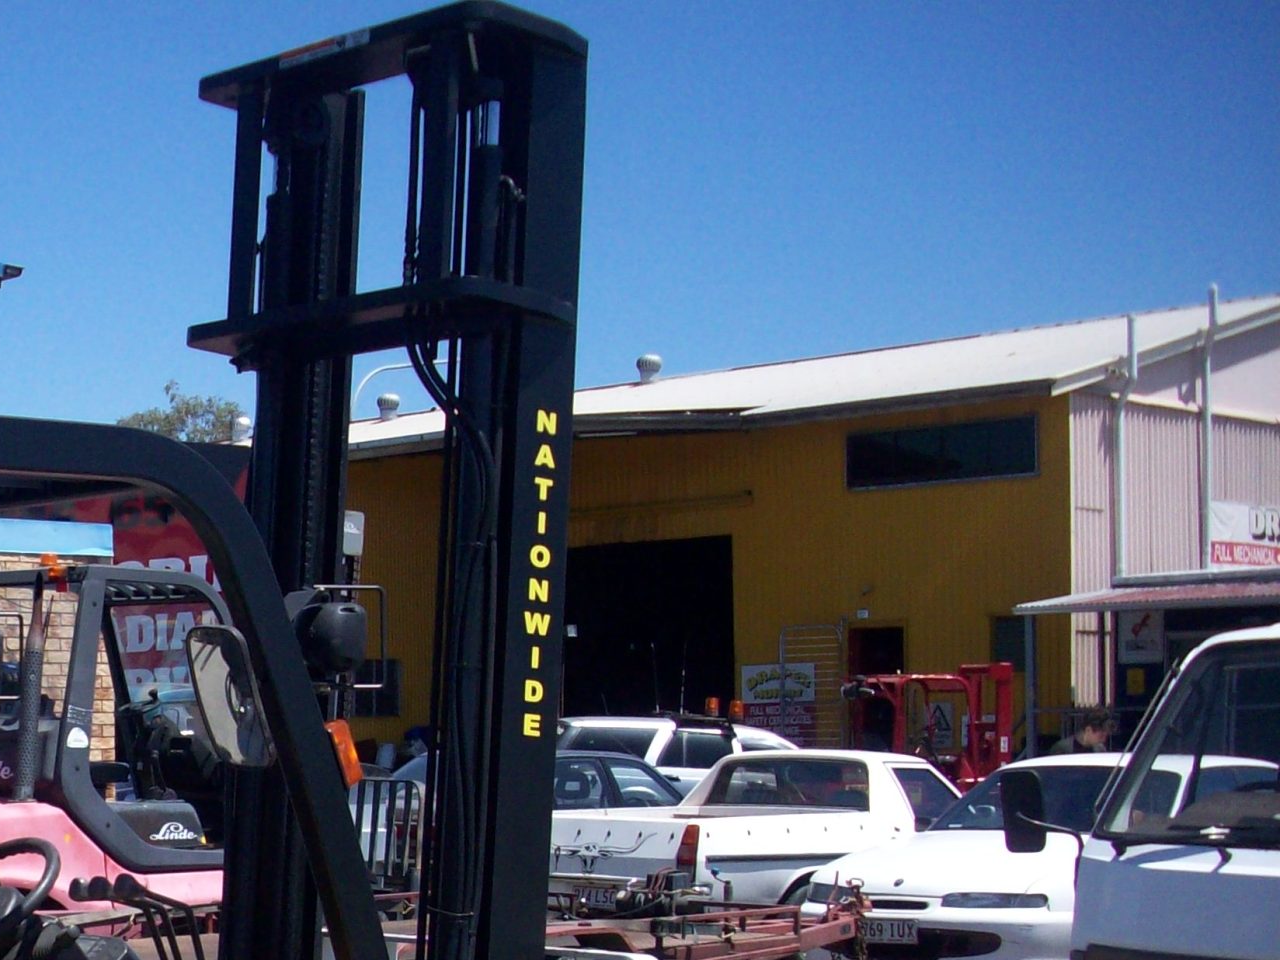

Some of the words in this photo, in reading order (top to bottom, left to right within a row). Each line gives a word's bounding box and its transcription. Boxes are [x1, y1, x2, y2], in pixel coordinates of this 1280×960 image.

[1214, 543, 1232, 562] FULL
[523, 409, 557, 737] NATIONWIDE
[150, 821, 198, 840] Linde
